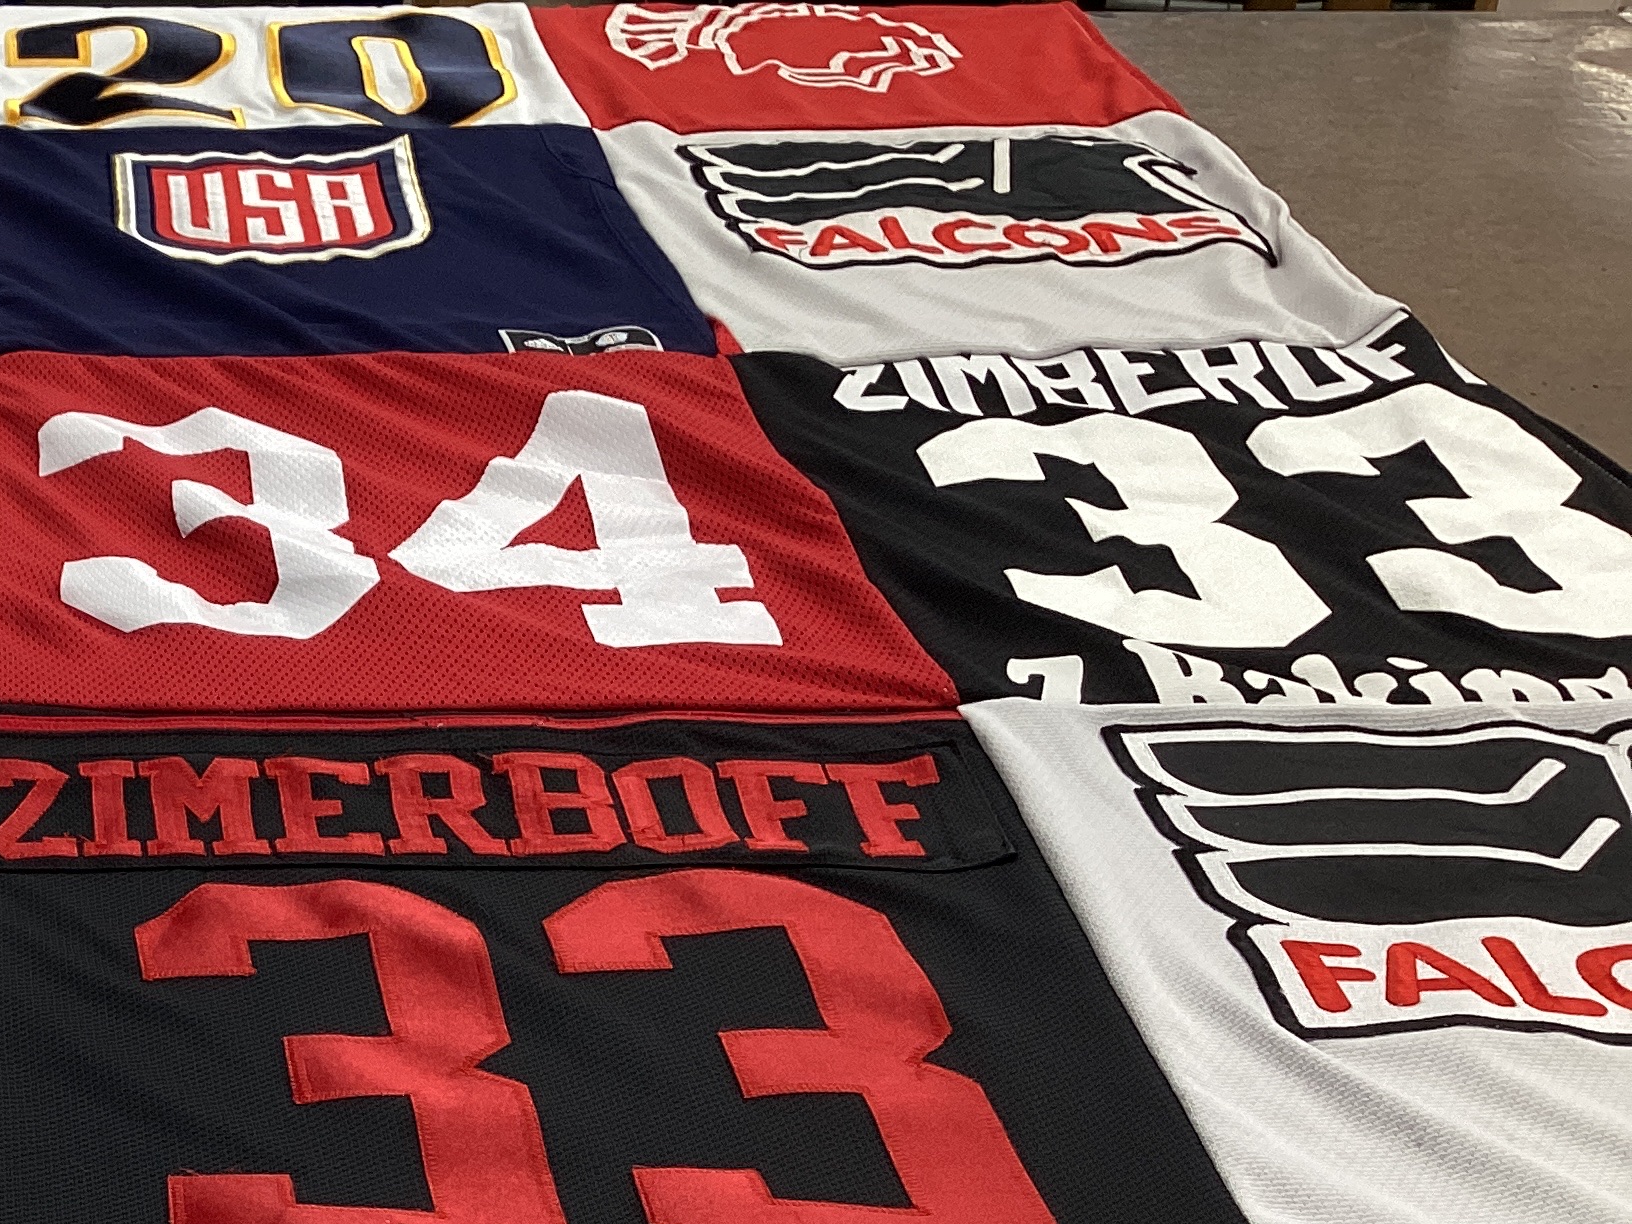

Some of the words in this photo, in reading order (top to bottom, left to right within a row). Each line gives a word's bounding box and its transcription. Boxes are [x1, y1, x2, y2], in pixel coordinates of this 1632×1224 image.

[5, 14, 517, 127] 20
[169, 169, 376, 246] USA
[755, 215, 1242, 257] FALCONS
[38, 390, 783, 648] 34
[916, 383, 1632, 648] 33
